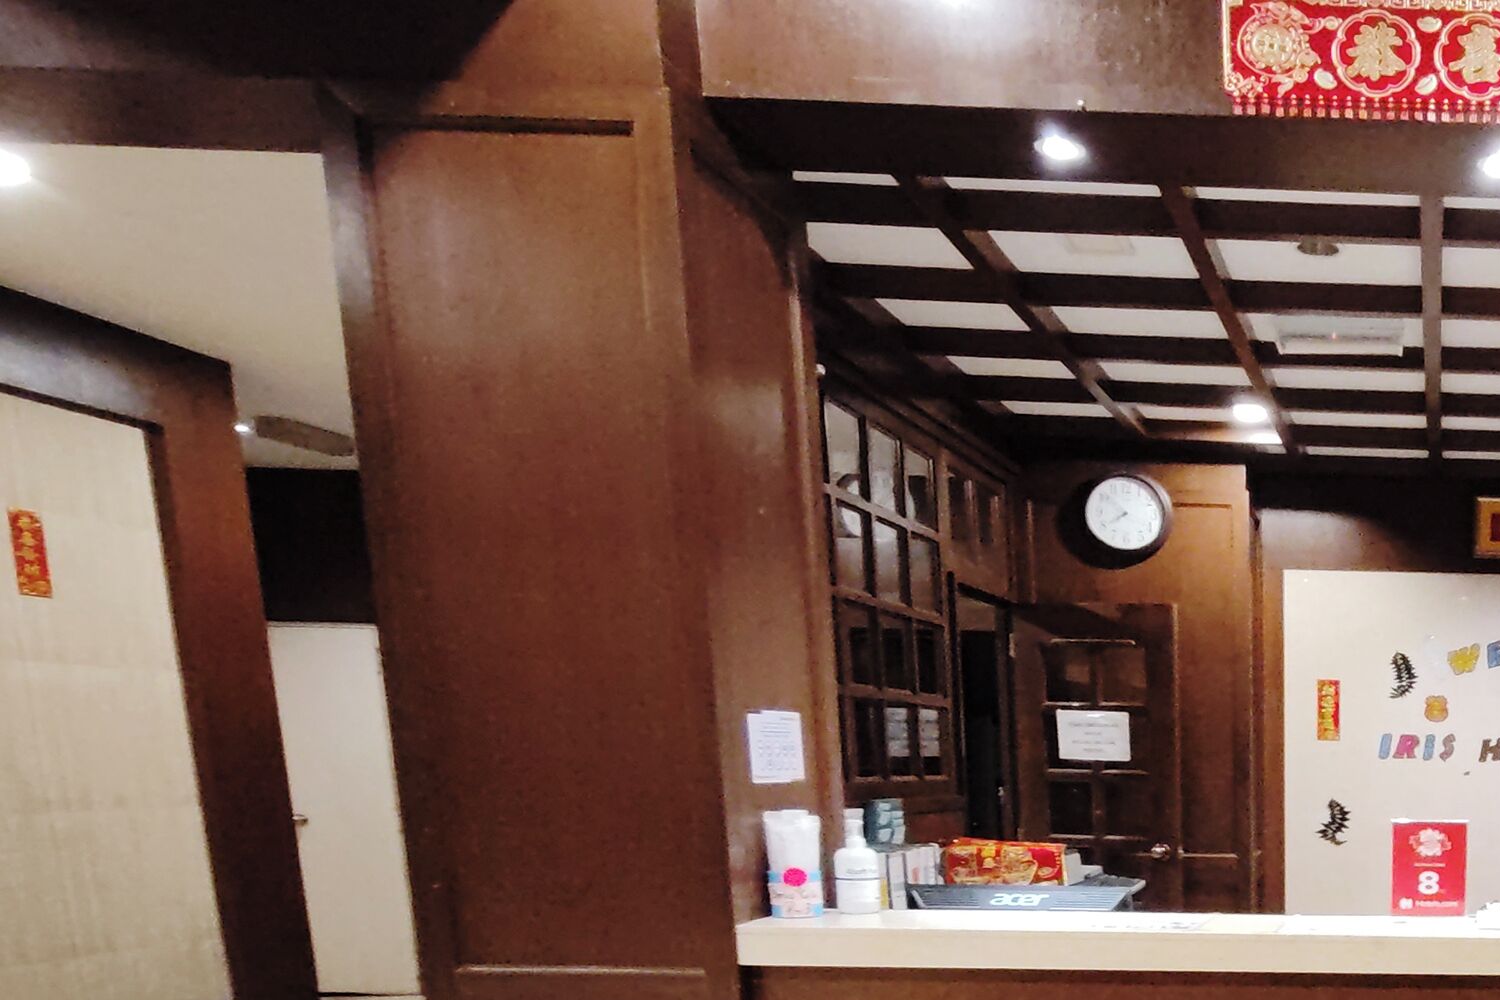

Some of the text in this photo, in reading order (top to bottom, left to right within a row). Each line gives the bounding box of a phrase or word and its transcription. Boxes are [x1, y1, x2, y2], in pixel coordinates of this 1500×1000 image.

[1378, 733, 1456, 762] IRIS
[1418, 871, 1440, 895] 8
[990, 893, 1050, 907] acer
